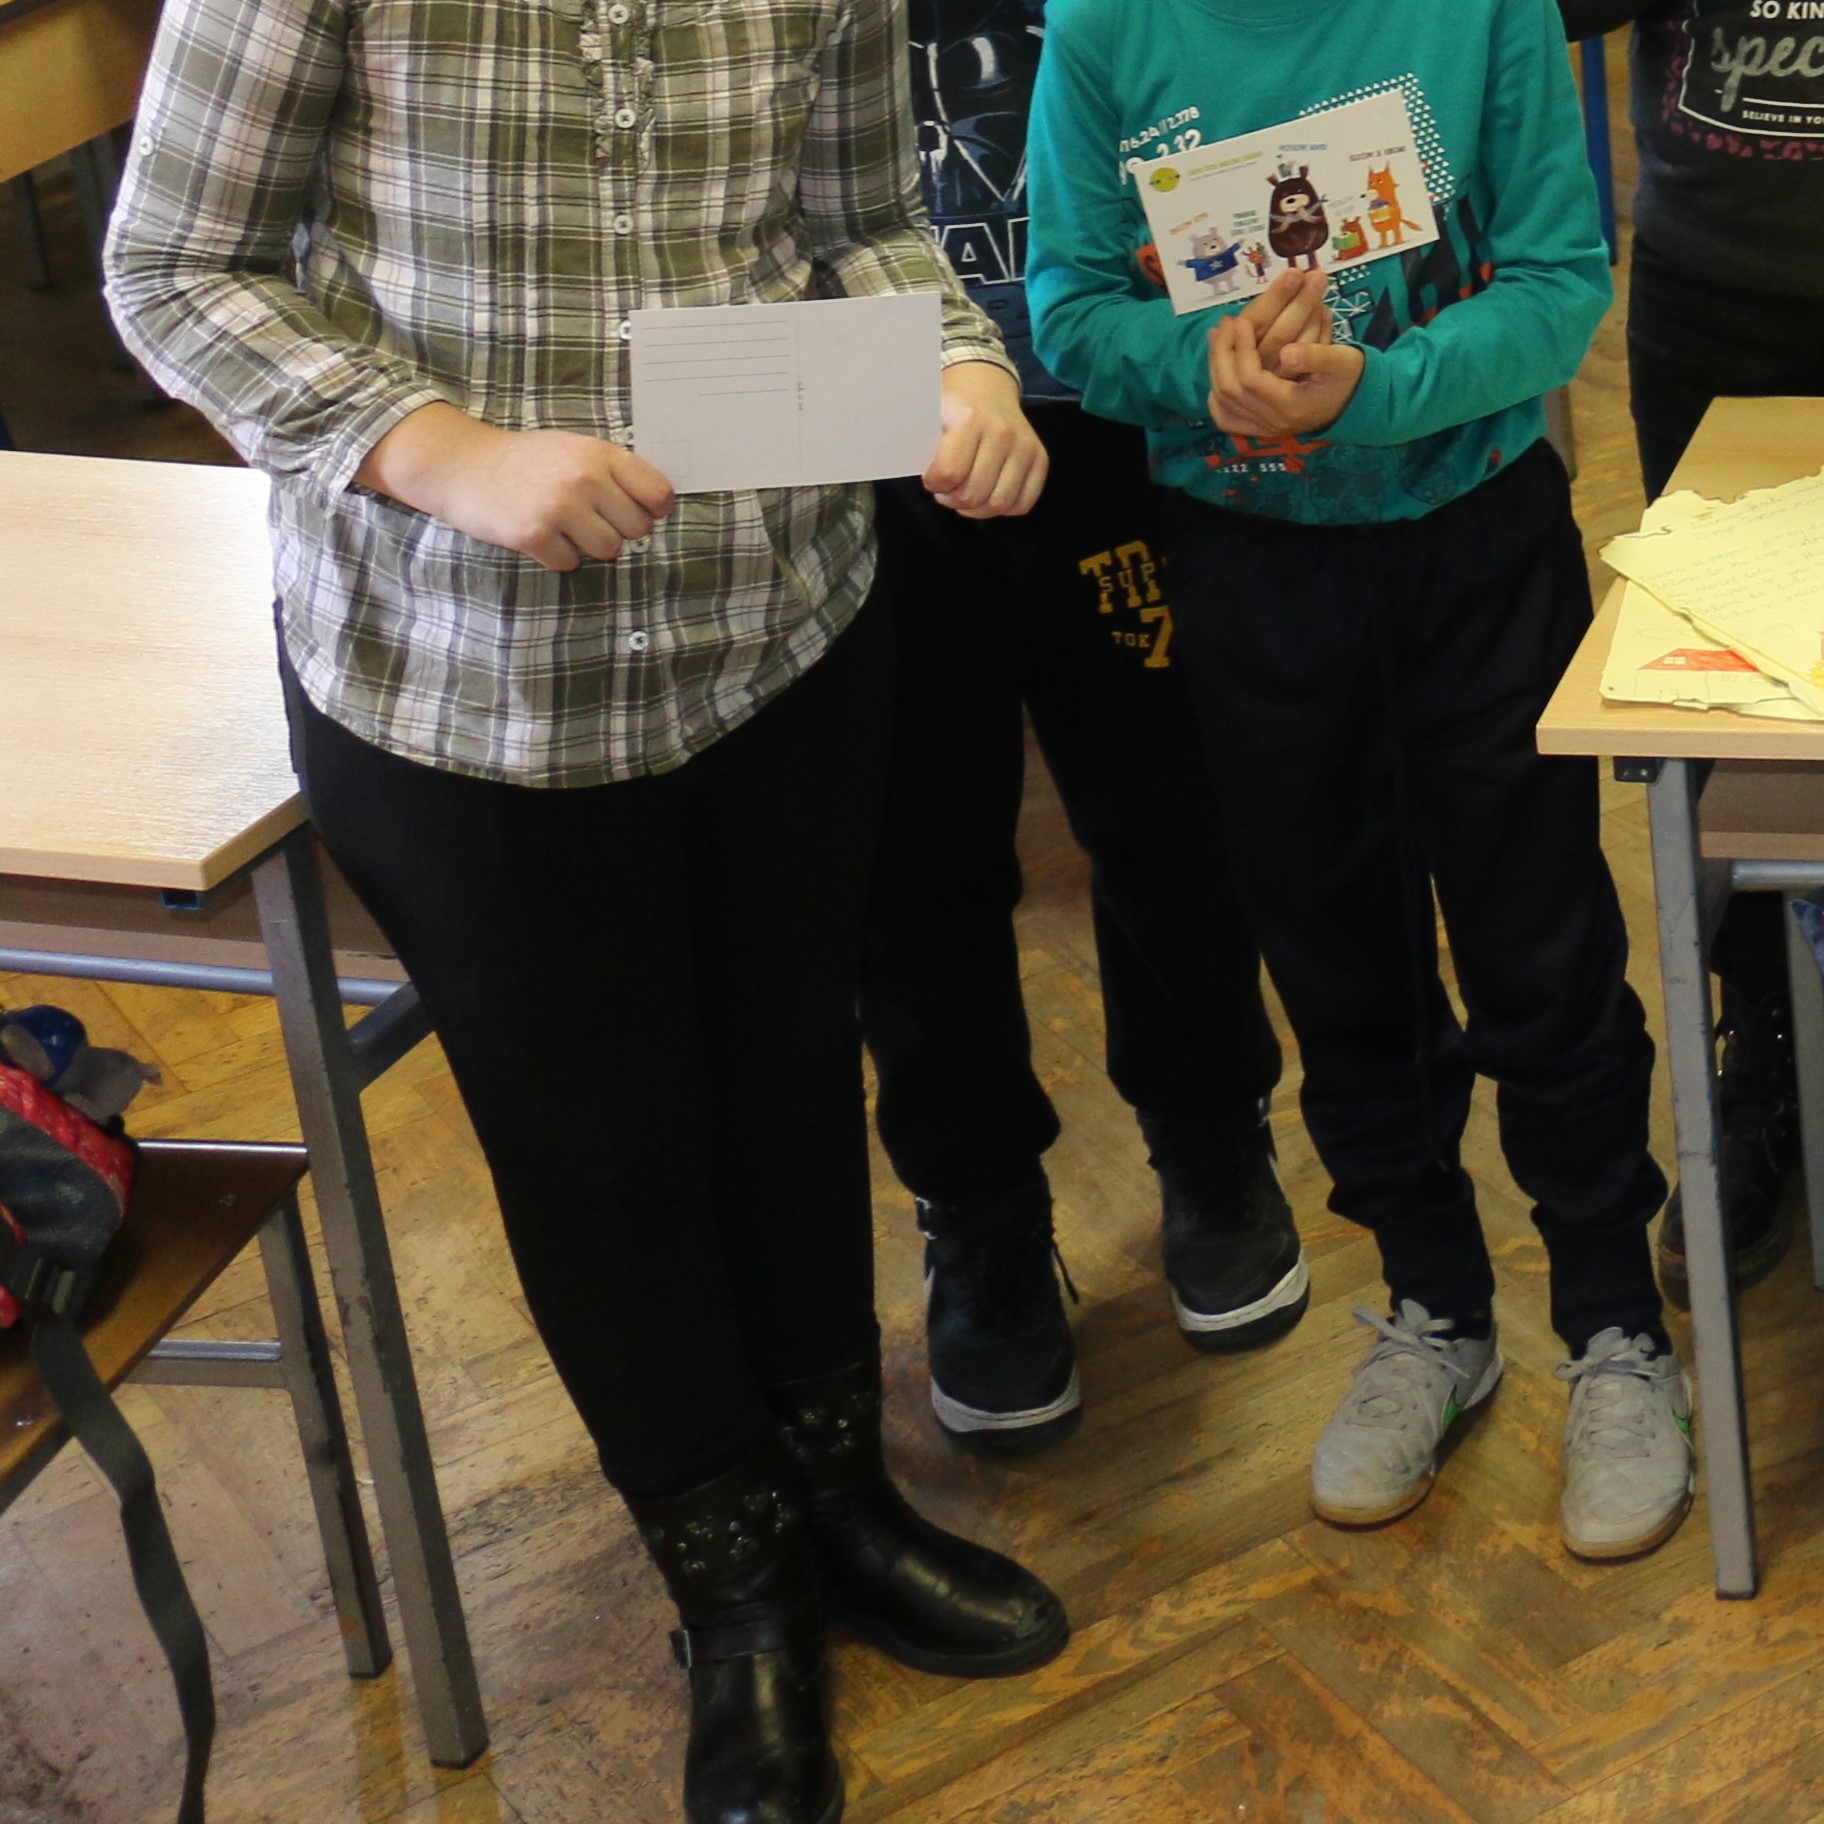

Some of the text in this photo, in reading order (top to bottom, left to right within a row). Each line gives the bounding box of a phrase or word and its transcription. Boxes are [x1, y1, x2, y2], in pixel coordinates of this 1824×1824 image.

[1750, 0, 1781, 19] SO
[1742, 109, 1785, 123] BELIEVE
[1140, 605, 1174, 669] 7
